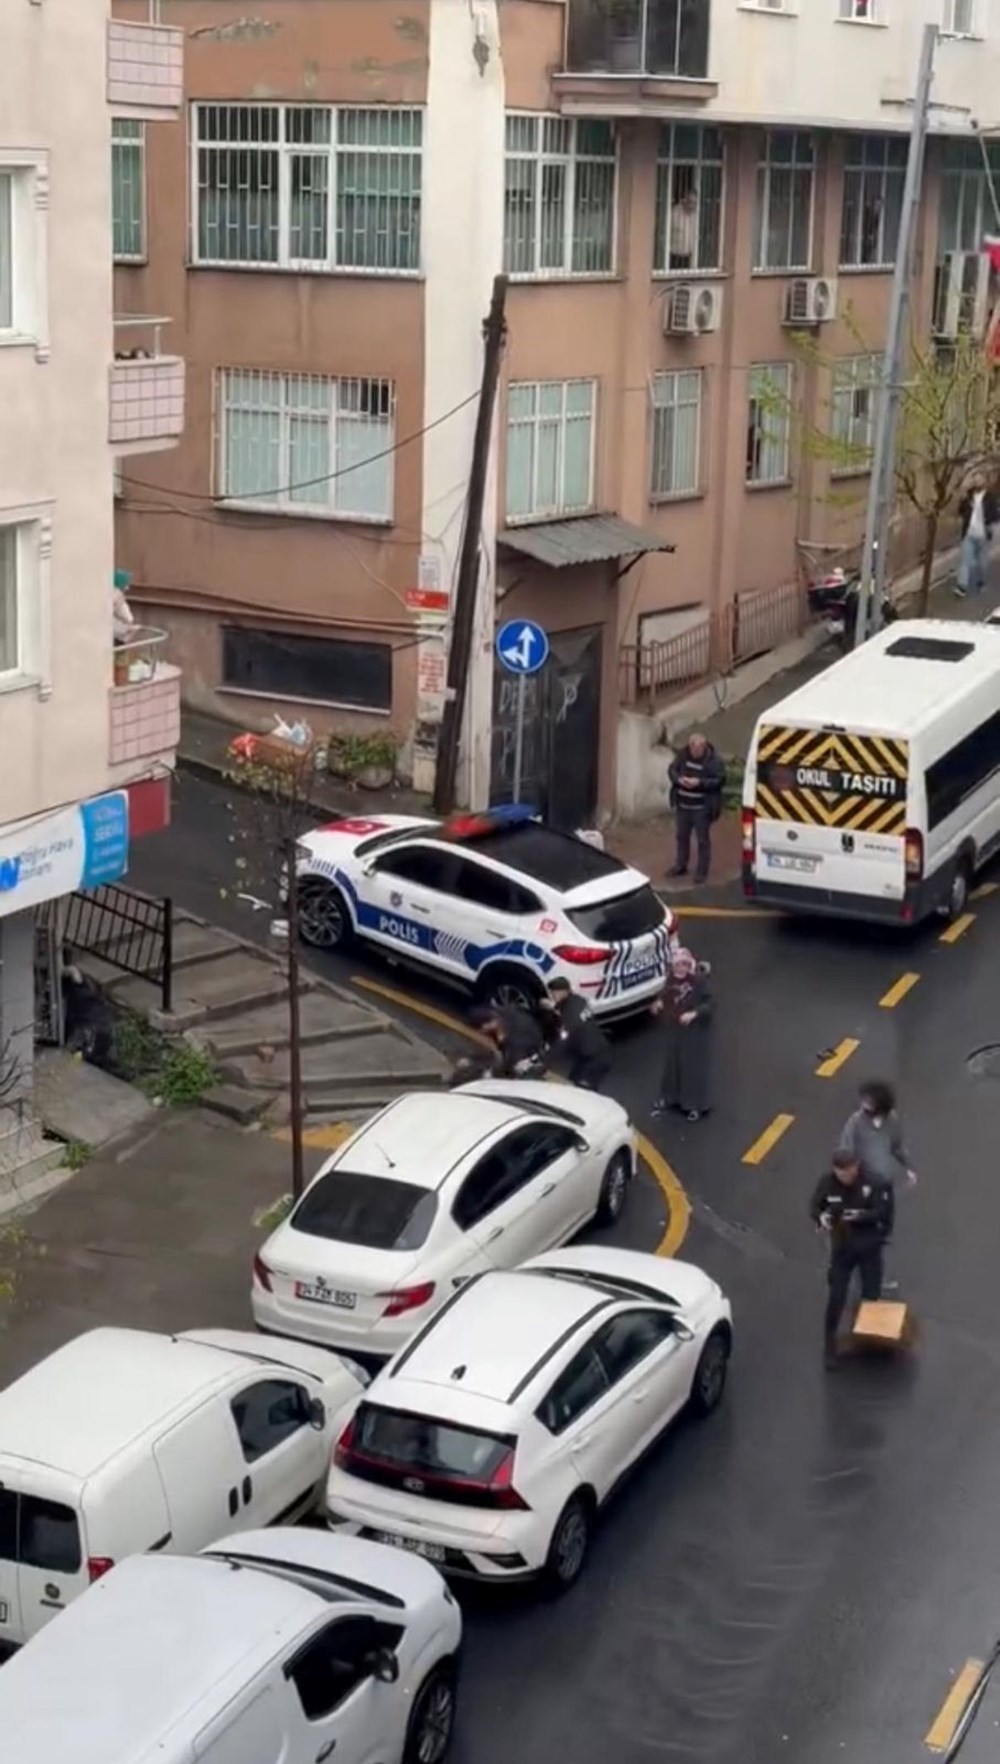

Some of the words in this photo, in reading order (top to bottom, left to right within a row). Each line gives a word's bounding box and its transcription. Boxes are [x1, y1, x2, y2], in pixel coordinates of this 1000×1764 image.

[797, 768, 832, 787] OKUL
[841, 773, 896, 795] TAŞITI
[379, 916, 419, 944] POLİS
